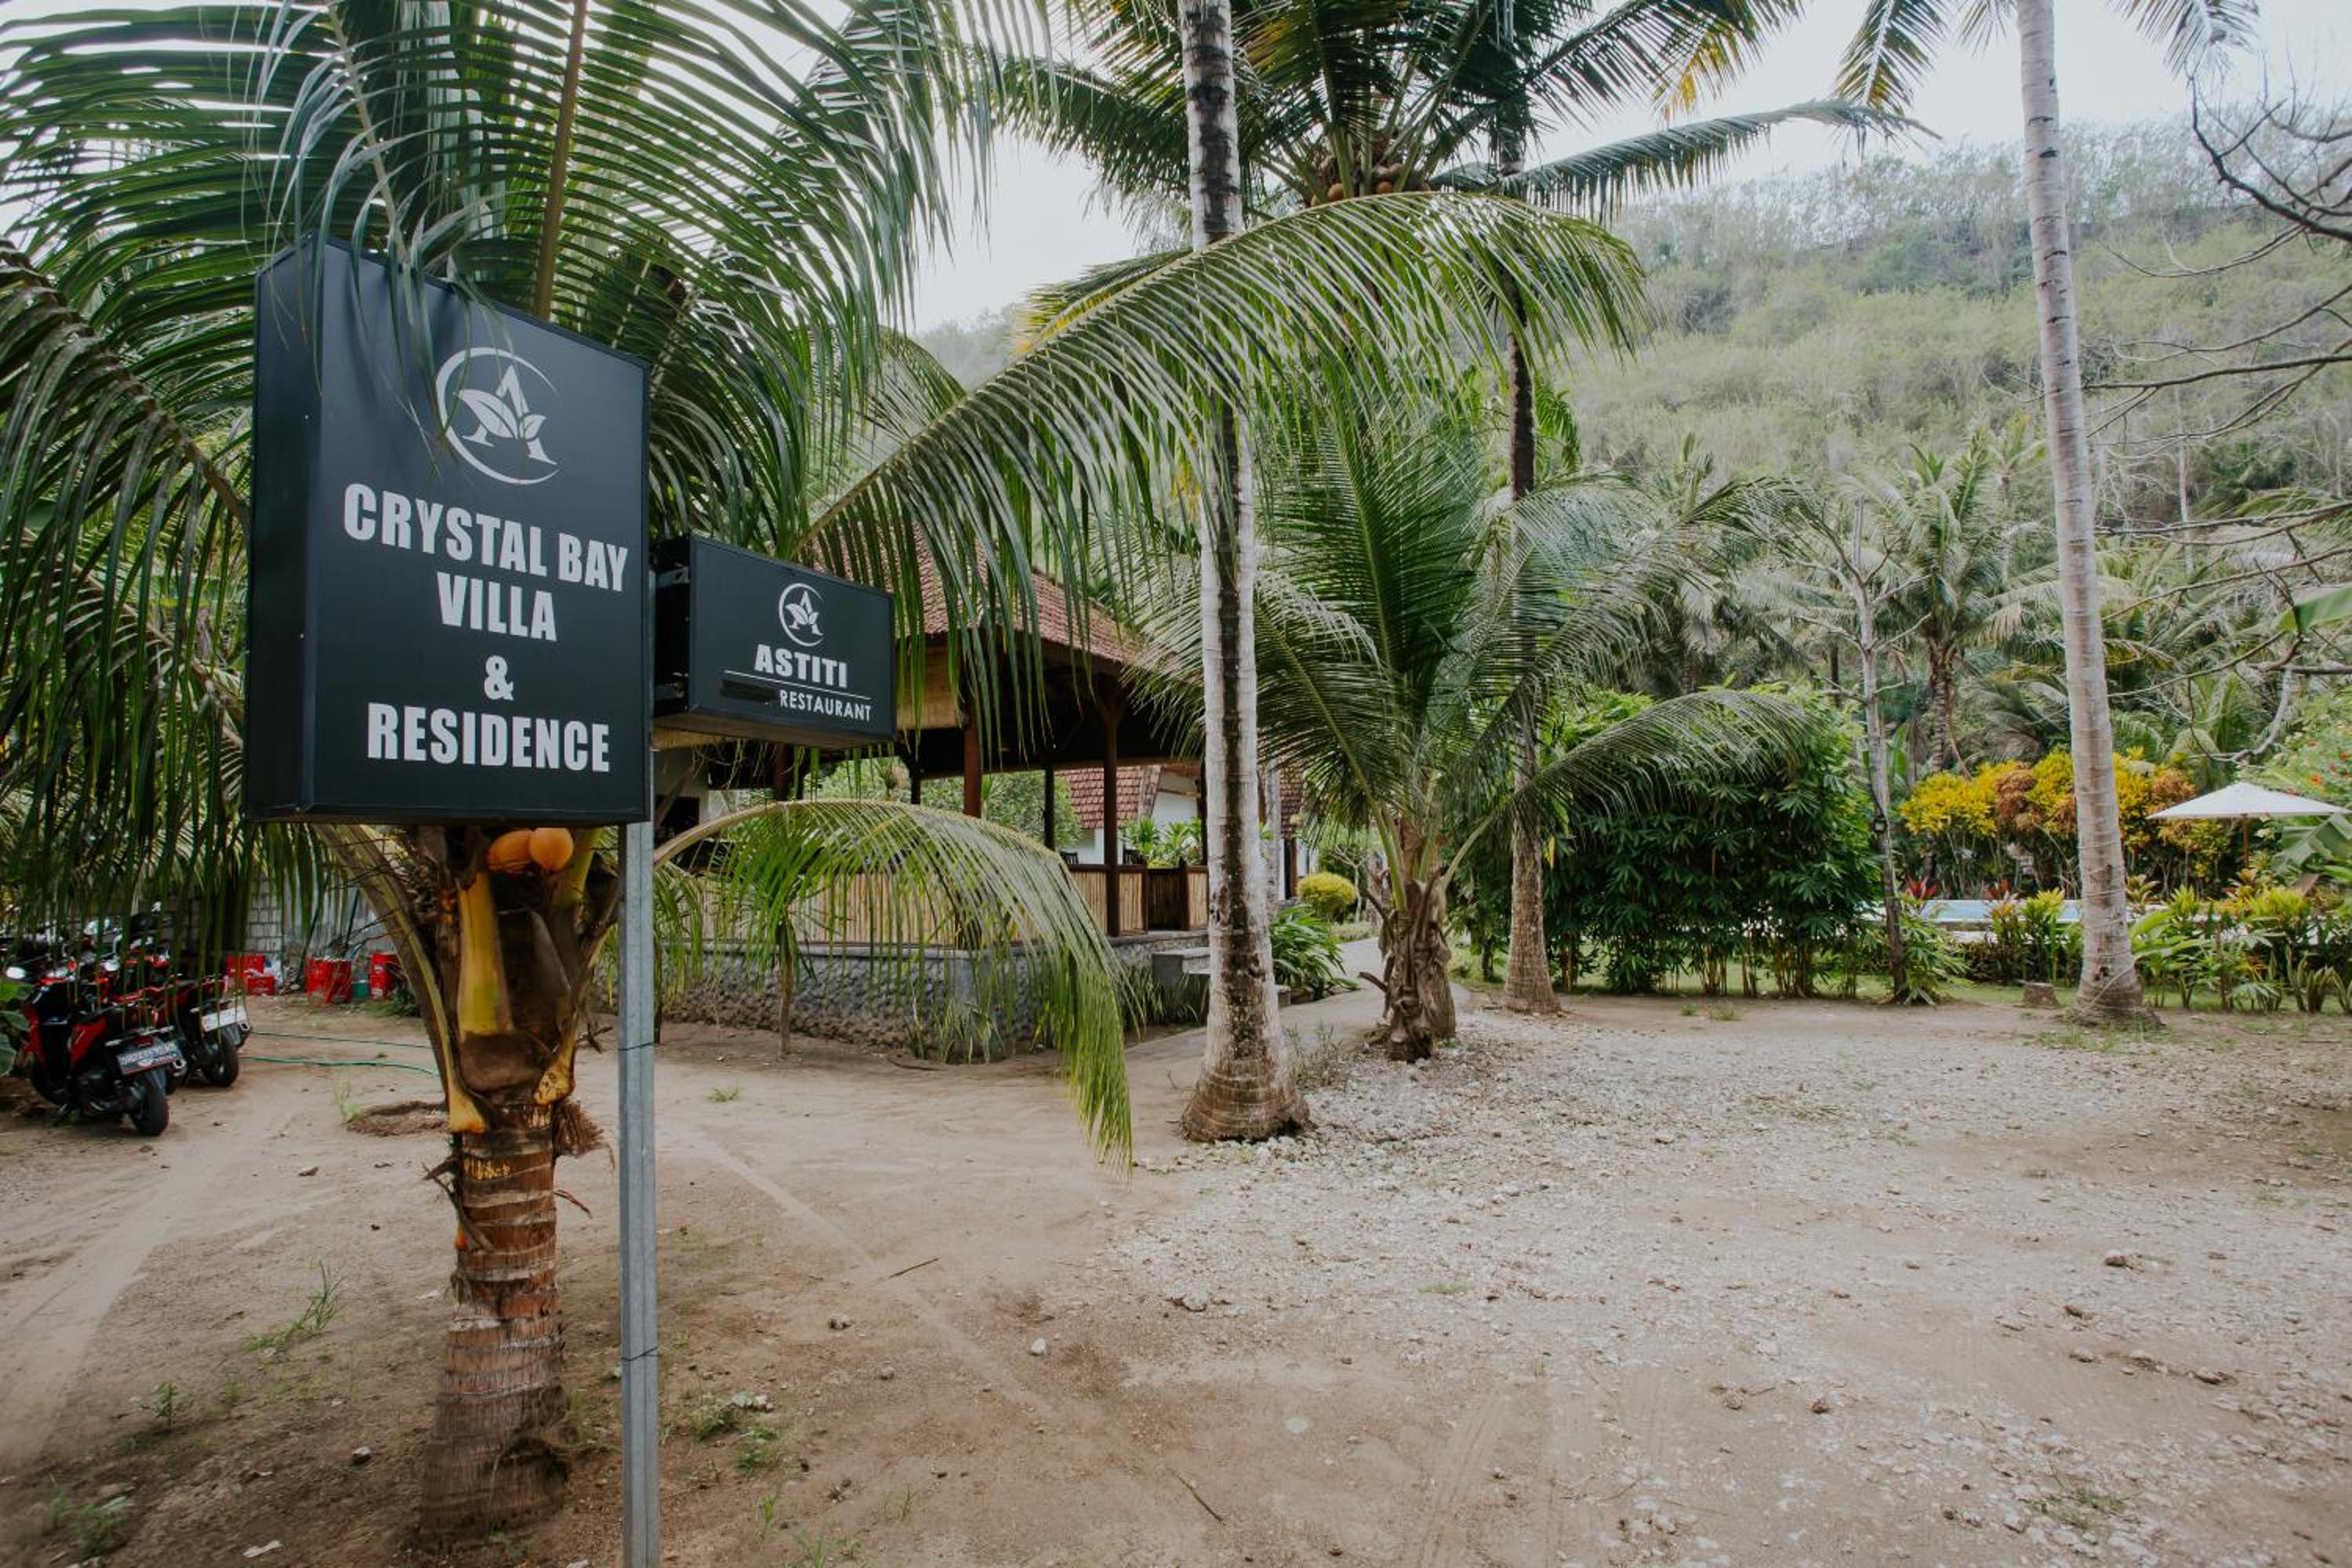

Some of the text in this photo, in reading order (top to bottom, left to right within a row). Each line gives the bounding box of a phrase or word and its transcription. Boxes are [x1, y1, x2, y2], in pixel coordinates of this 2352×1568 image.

[344, 483, 627, 591] CRYSTAL BAY
[437, 572, 557, 641] VILLA
[484, 655, 514, 701] &
[754, 644, 847, 688] ASTITI
[779, 689, 871, 721] RESTAURANT
[368, 702, 609, 772] RESIDENCE
